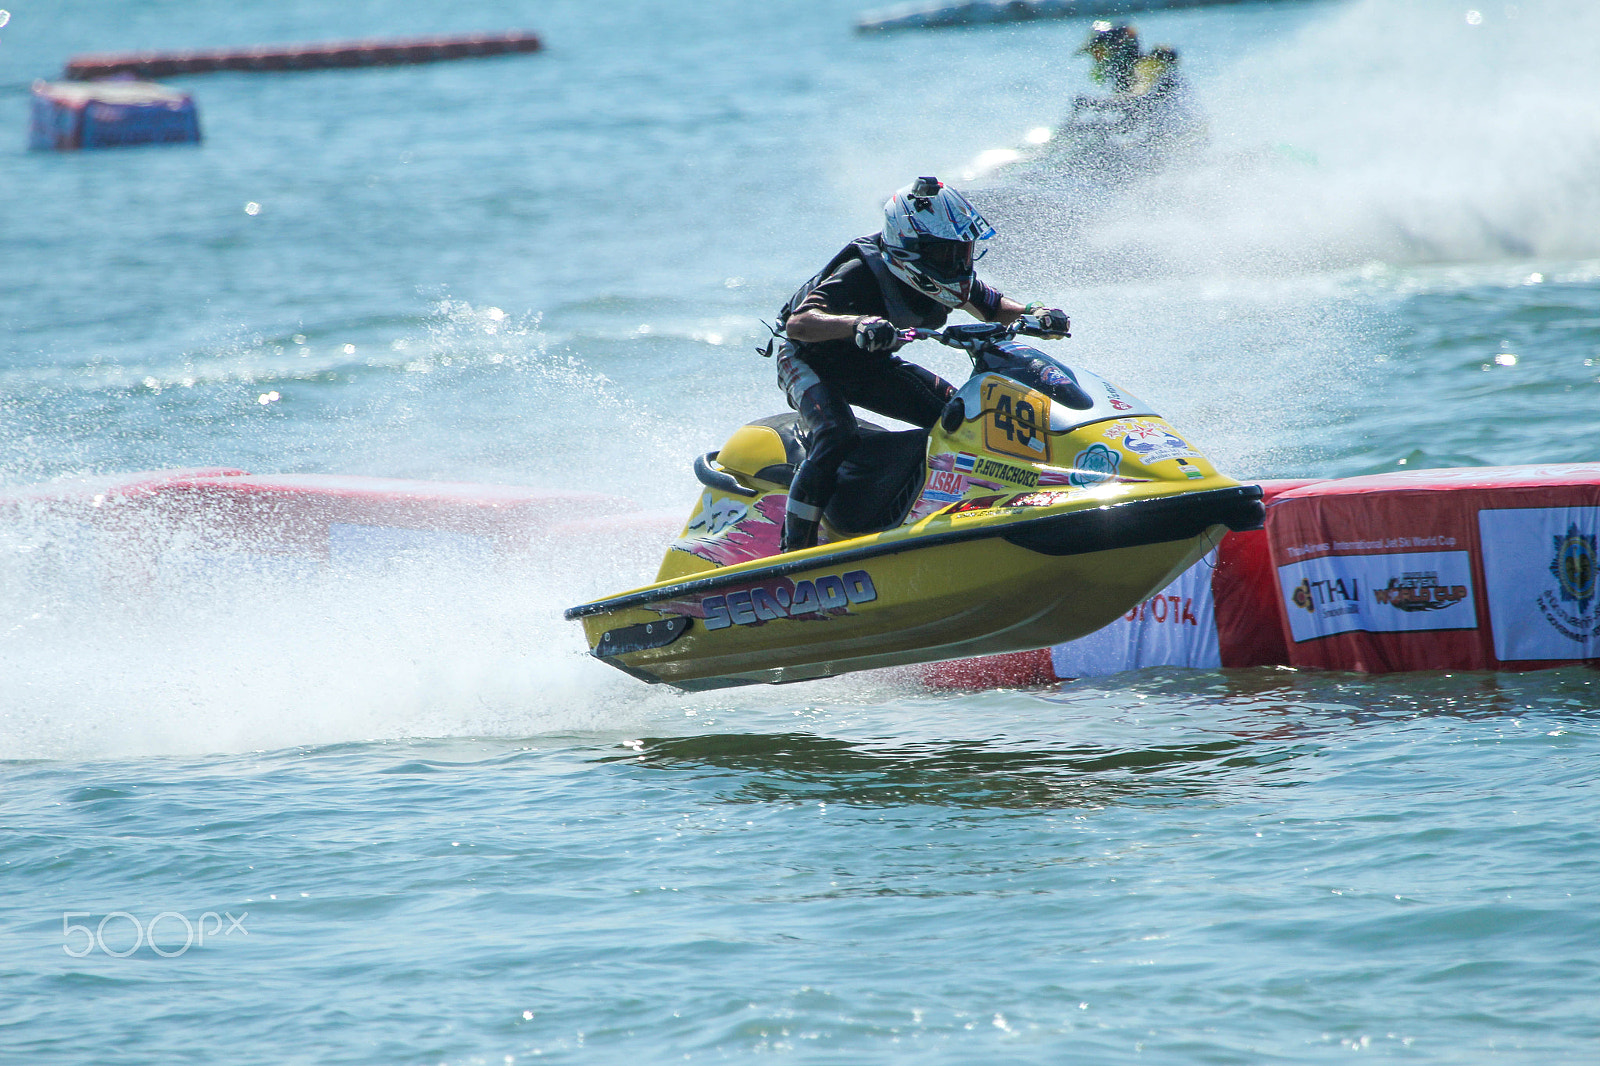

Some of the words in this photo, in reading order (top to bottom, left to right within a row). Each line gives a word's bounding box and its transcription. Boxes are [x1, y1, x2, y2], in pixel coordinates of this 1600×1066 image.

[987, 383, 998, 400] T
[995, 394, 1037, 446] 49
[974, 458, 1040, 488] P.HUTACHOKE
[1413, 536, 1437, 547] World
[1438, 535, 1457, 548] Cup
[1311, 578, 1359, 605] THAI
[1434, 585, 1468, 601] CUP
